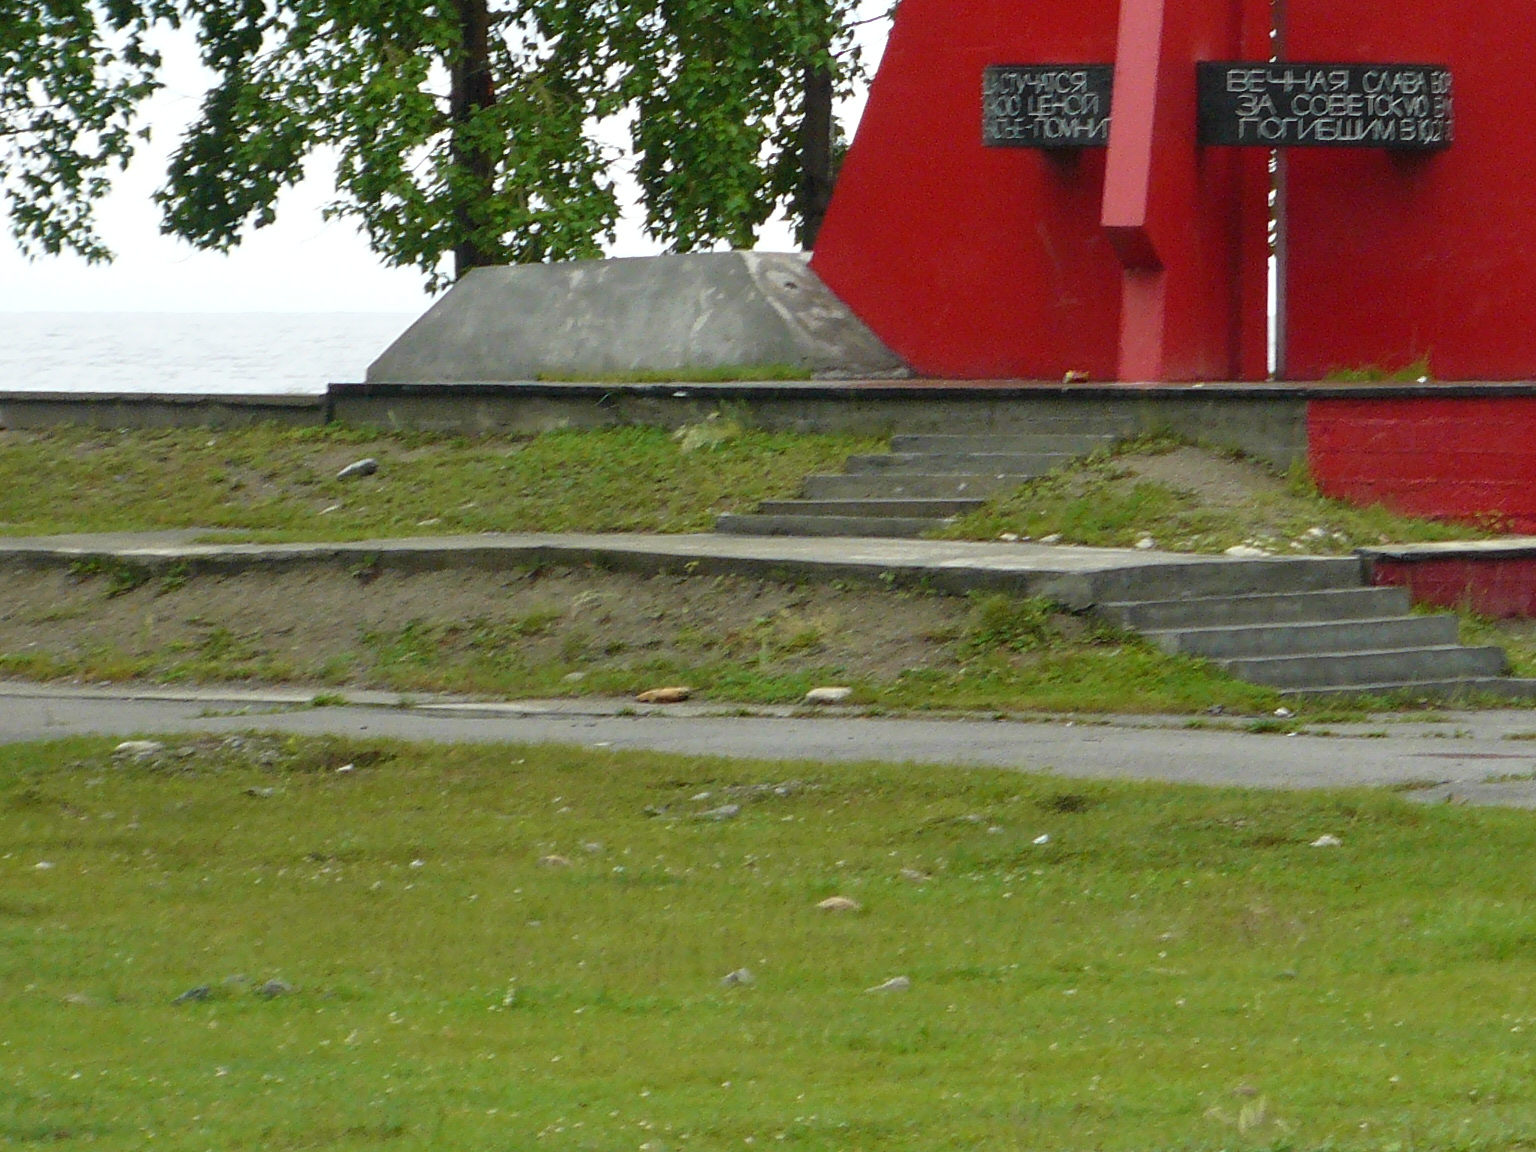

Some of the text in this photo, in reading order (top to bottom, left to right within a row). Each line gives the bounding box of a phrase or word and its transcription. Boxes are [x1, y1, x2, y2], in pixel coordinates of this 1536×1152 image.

[1227, 69, 1349, 92] ВЕЧНАЯ
[1362, 69, 1426, 93] СЛАВА
[1235, 93, 1277, 116] ЗА
[1291, 93, 1430, 117] СОВЕТСКУЮ
[1238, 117, 1395, 141] ПОГИБШИМ
